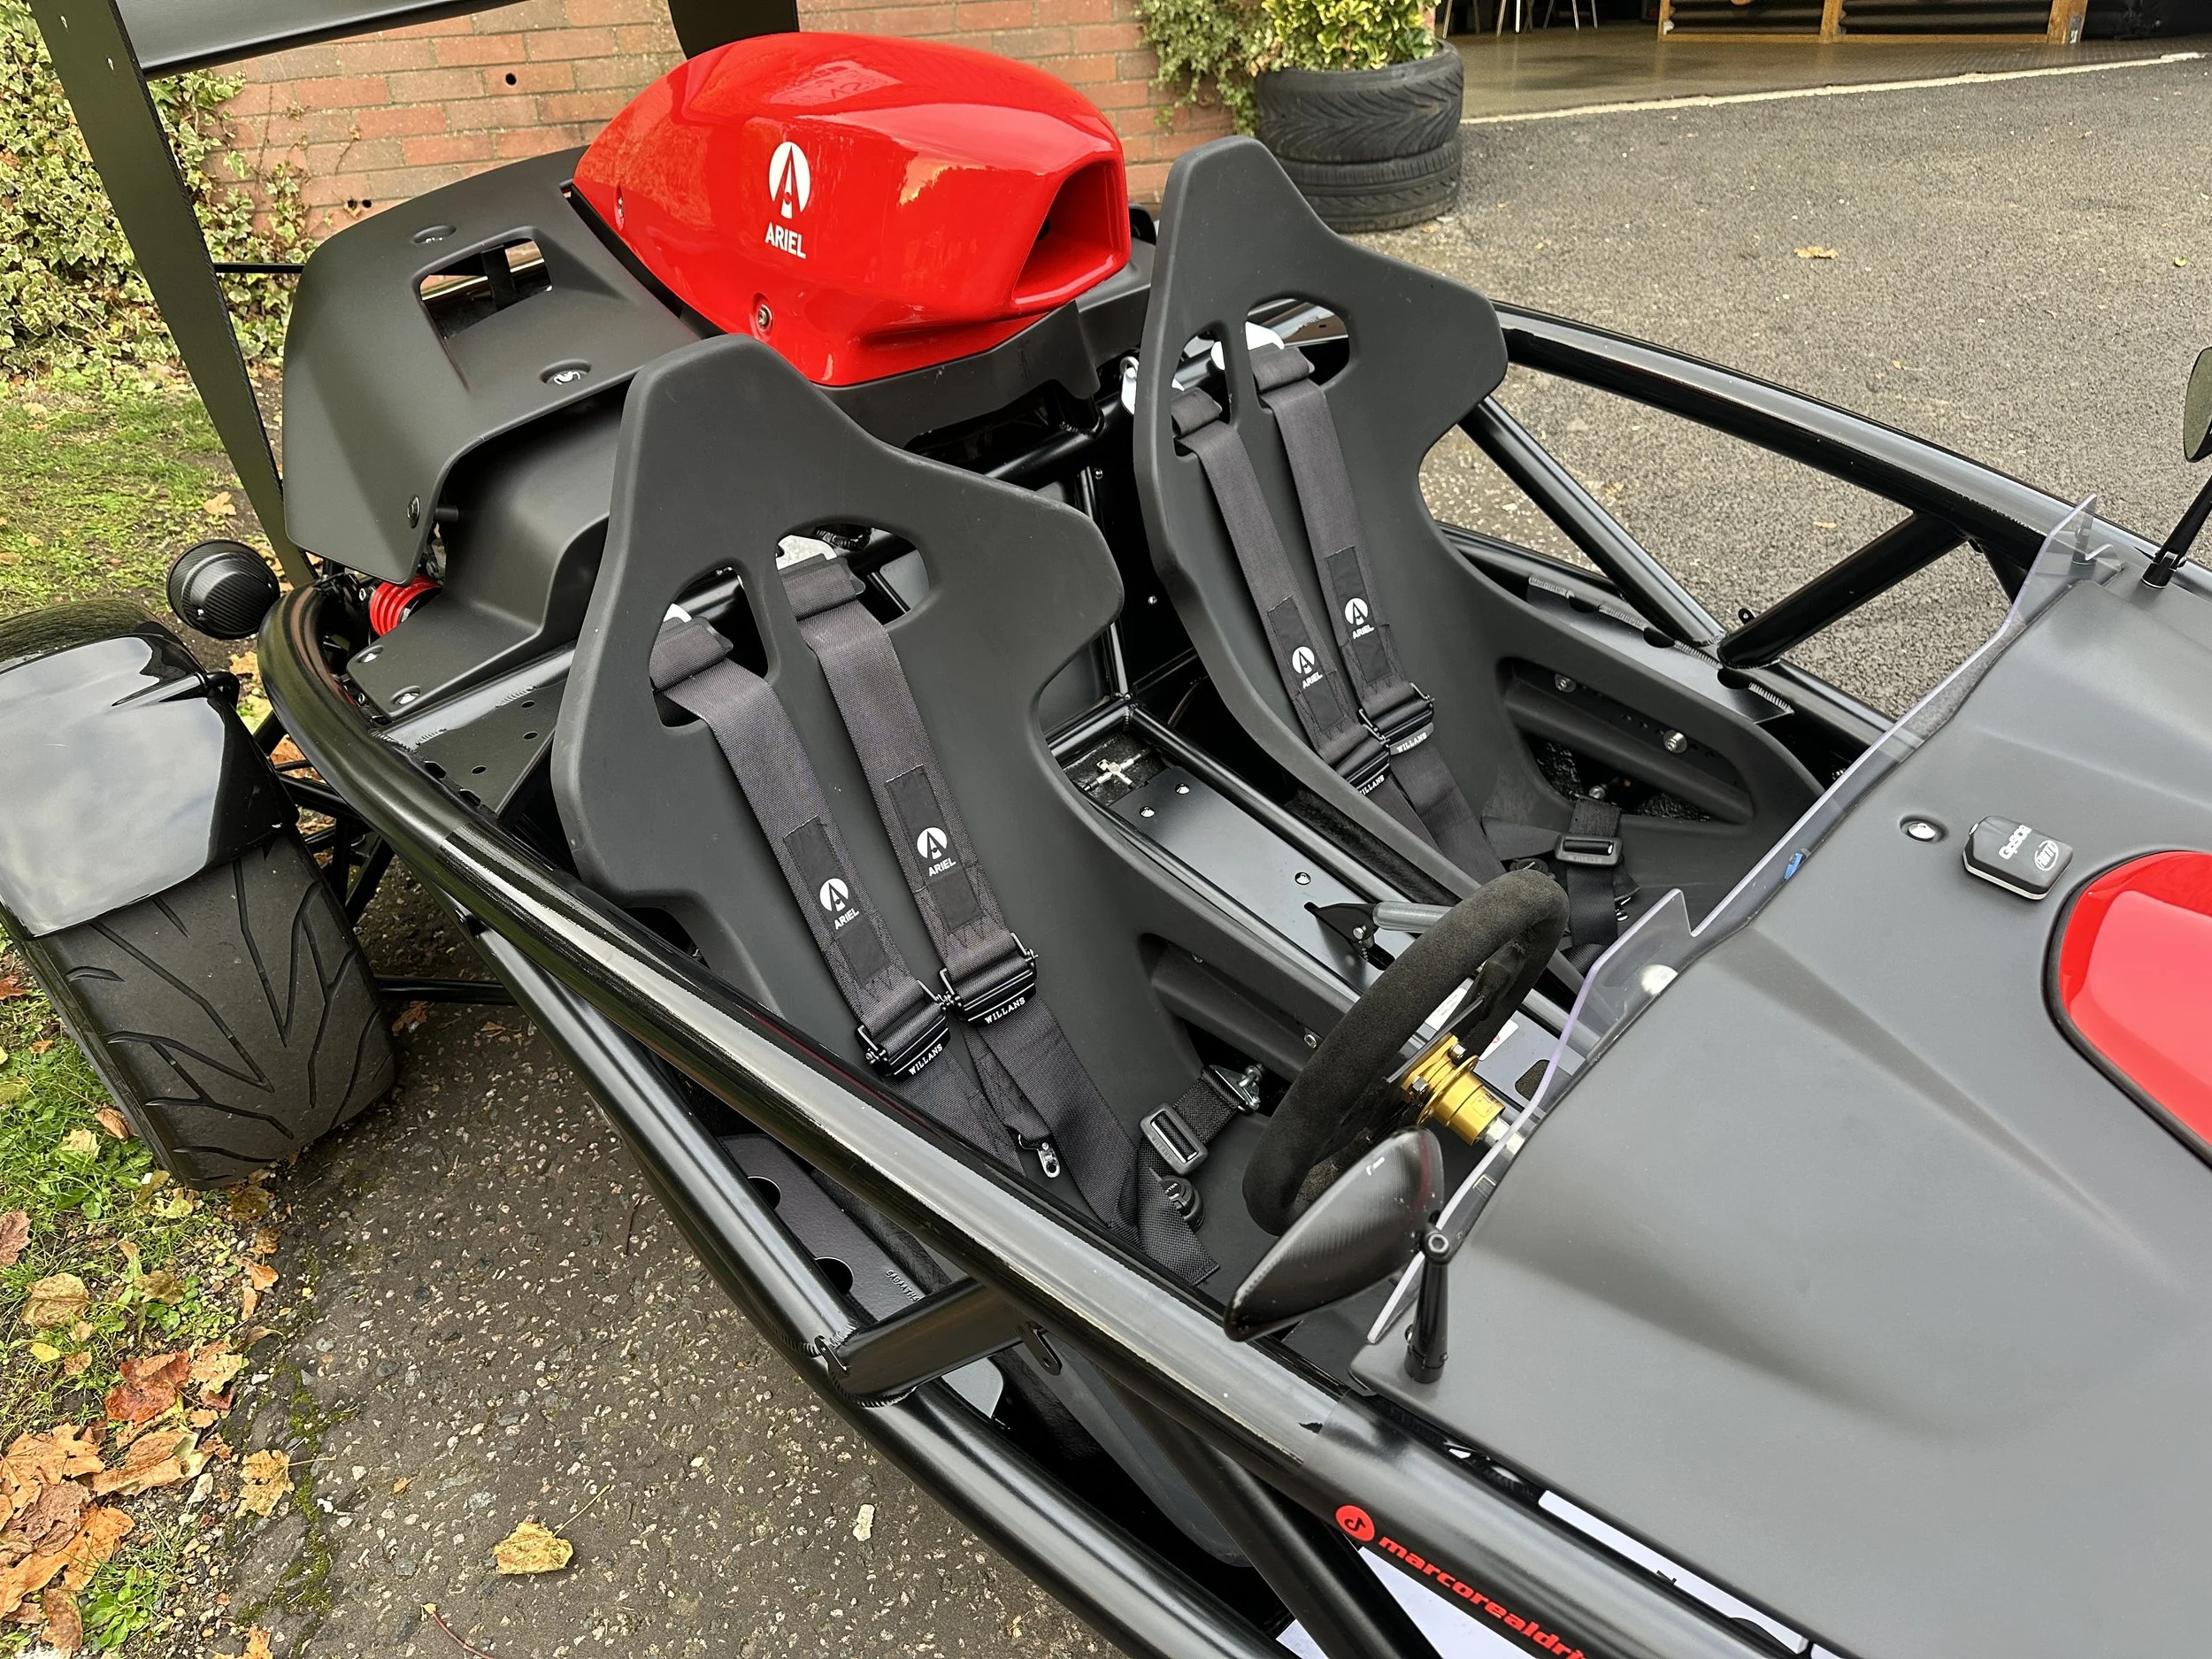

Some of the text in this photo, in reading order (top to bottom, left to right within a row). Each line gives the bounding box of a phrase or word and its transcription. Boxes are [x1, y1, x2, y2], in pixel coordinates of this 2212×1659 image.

[764, 221, 807, 259] ARIEL
[1352, 624, 1375, 640] ARIEL
[1302, 672, 1324, 689] ARIEL
[1396, 732, 1428, 753] WILLANS
[1359, 774, 1386, 795] ILLANS
[928, 857, 956, 877] ARIEL
[833, 908, 859, 930] ARIEL
[984, 996, 1025, 1025] WILLANS
[908, 1043, 943, 1076] WILLANS
[1378, 1536, 1586, 1659] marcorealdri
